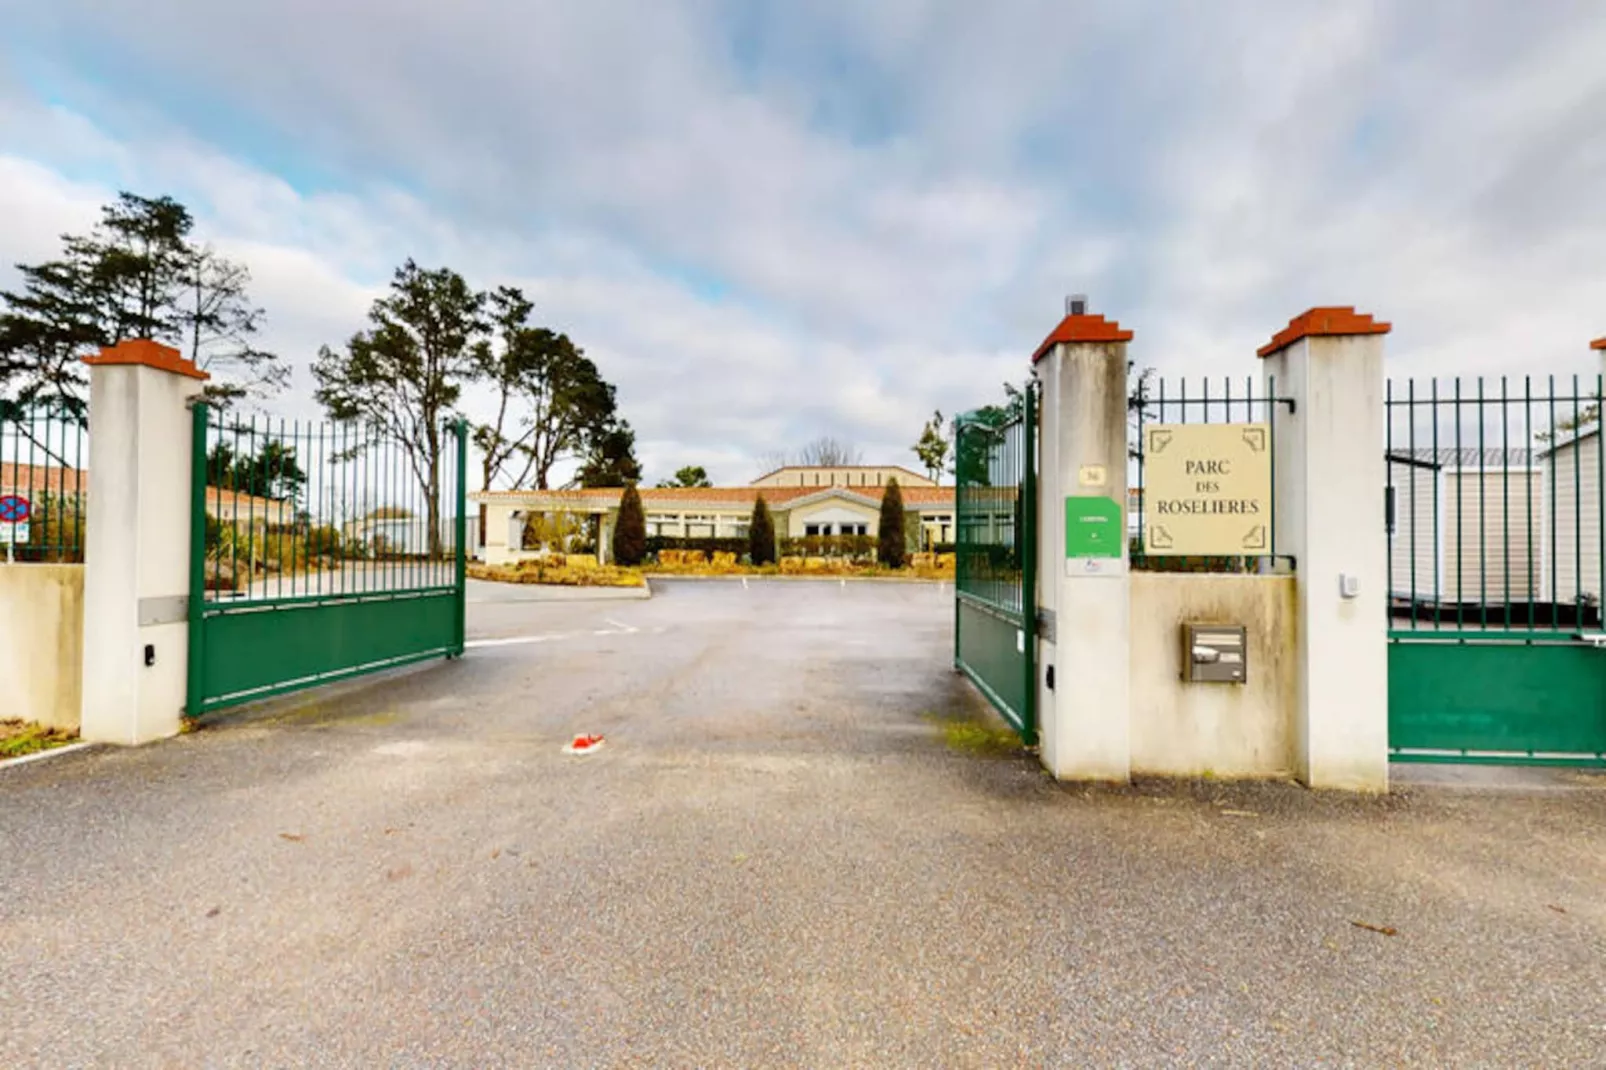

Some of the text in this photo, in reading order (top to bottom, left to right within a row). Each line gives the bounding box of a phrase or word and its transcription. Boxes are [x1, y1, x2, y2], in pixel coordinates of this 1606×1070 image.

[1185, 459, 1231, 475] PARC
[1195, 481, 1220, 493] DES
[1156, 500, 1259, 514] ROSELIERES
